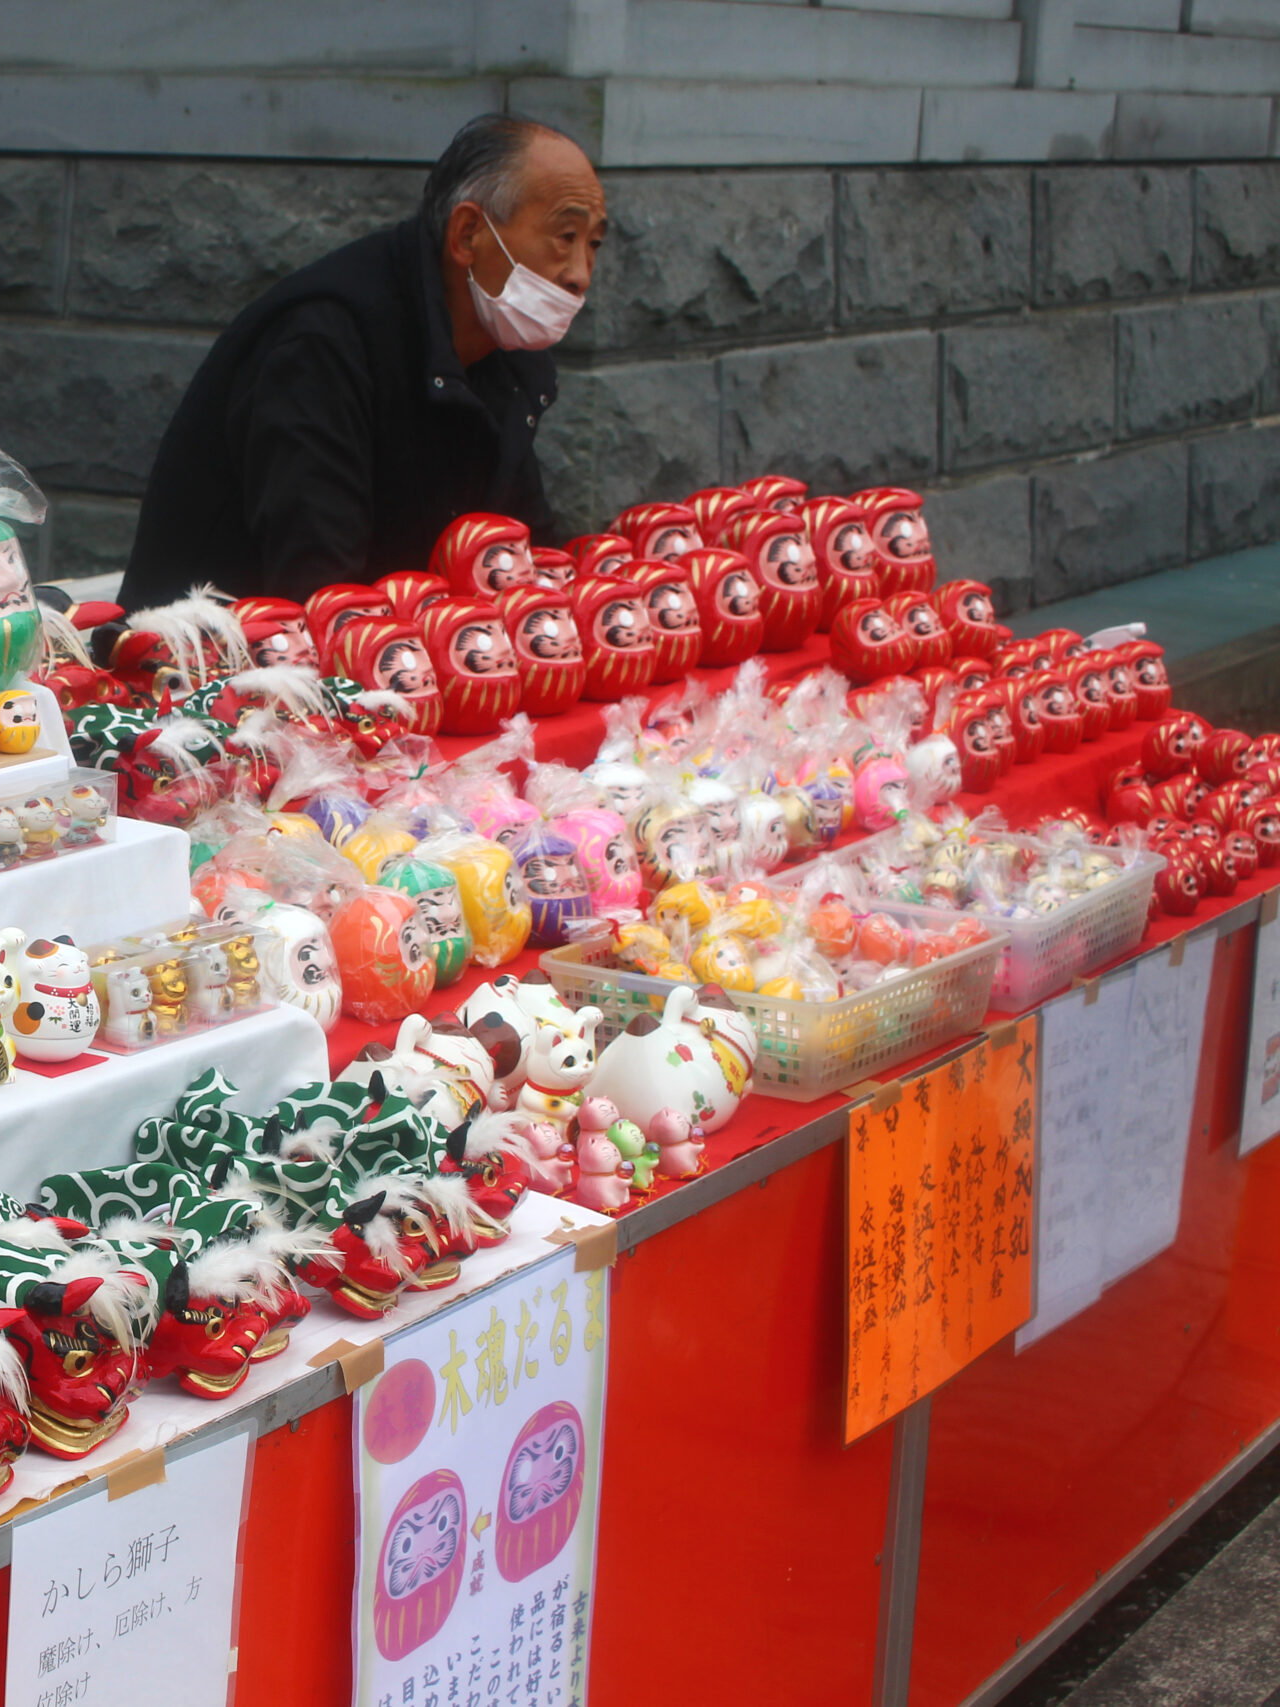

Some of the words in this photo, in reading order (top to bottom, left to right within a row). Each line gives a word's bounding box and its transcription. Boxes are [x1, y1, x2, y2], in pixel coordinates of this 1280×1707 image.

[67, 998, 82, 1033] 大開運
[438, 1268, 605, 1436] 木魂だるま
[41, 1523, 180, 1619] かしら獅子
[447, 1652, 462, 1707] いま
[506, 1602, 525, 1705] 使われて
[547, 1573, 570, 1705] が宿るとい
